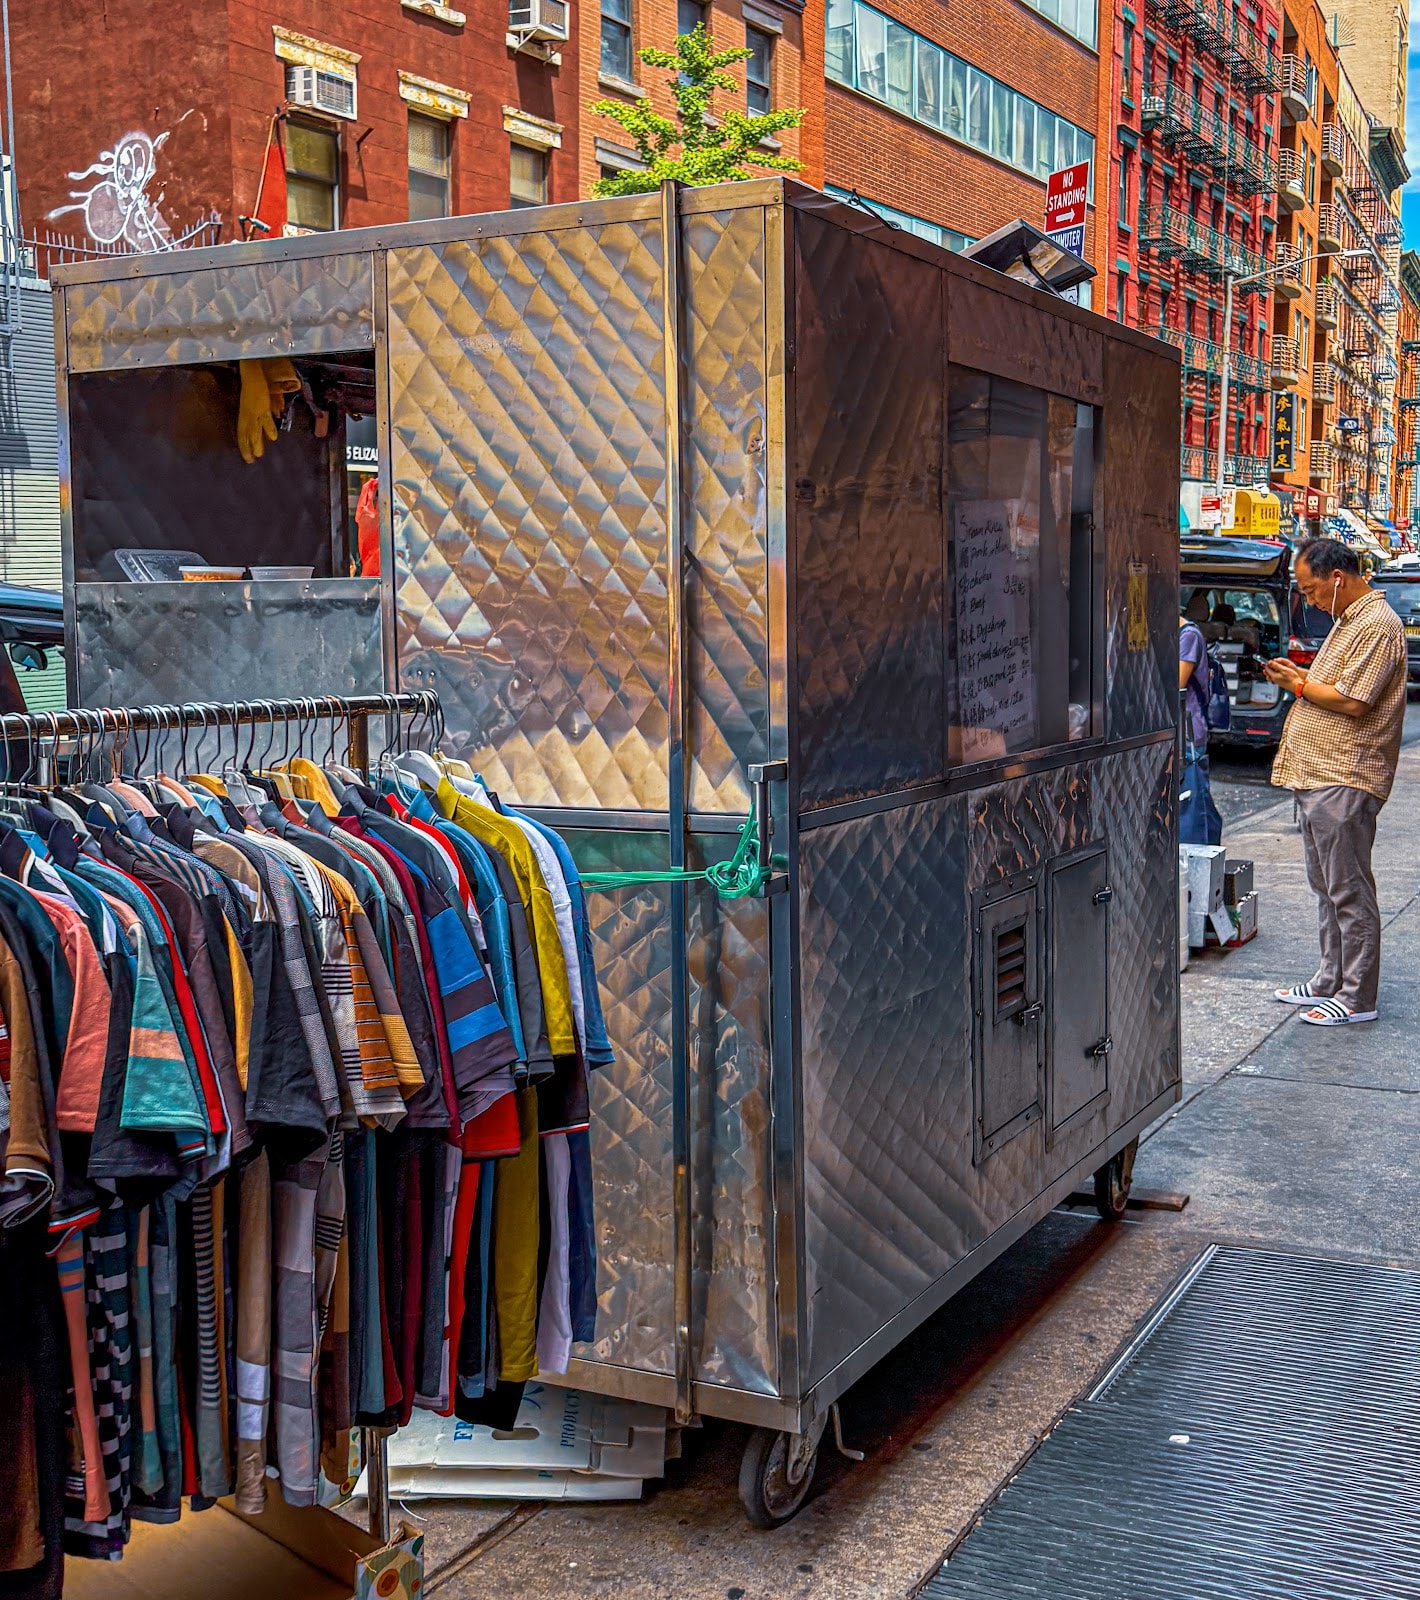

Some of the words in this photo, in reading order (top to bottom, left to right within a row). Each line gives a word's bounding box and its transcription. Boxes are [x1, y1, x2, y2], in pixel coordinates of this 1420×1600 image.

[1063, 171, 1073, 188] NO
[1048, 187, 1085, 211] STANDING
[1050, 230, 1080, 249] MMUTER
[352, 446, 378, 461] ELIZA
